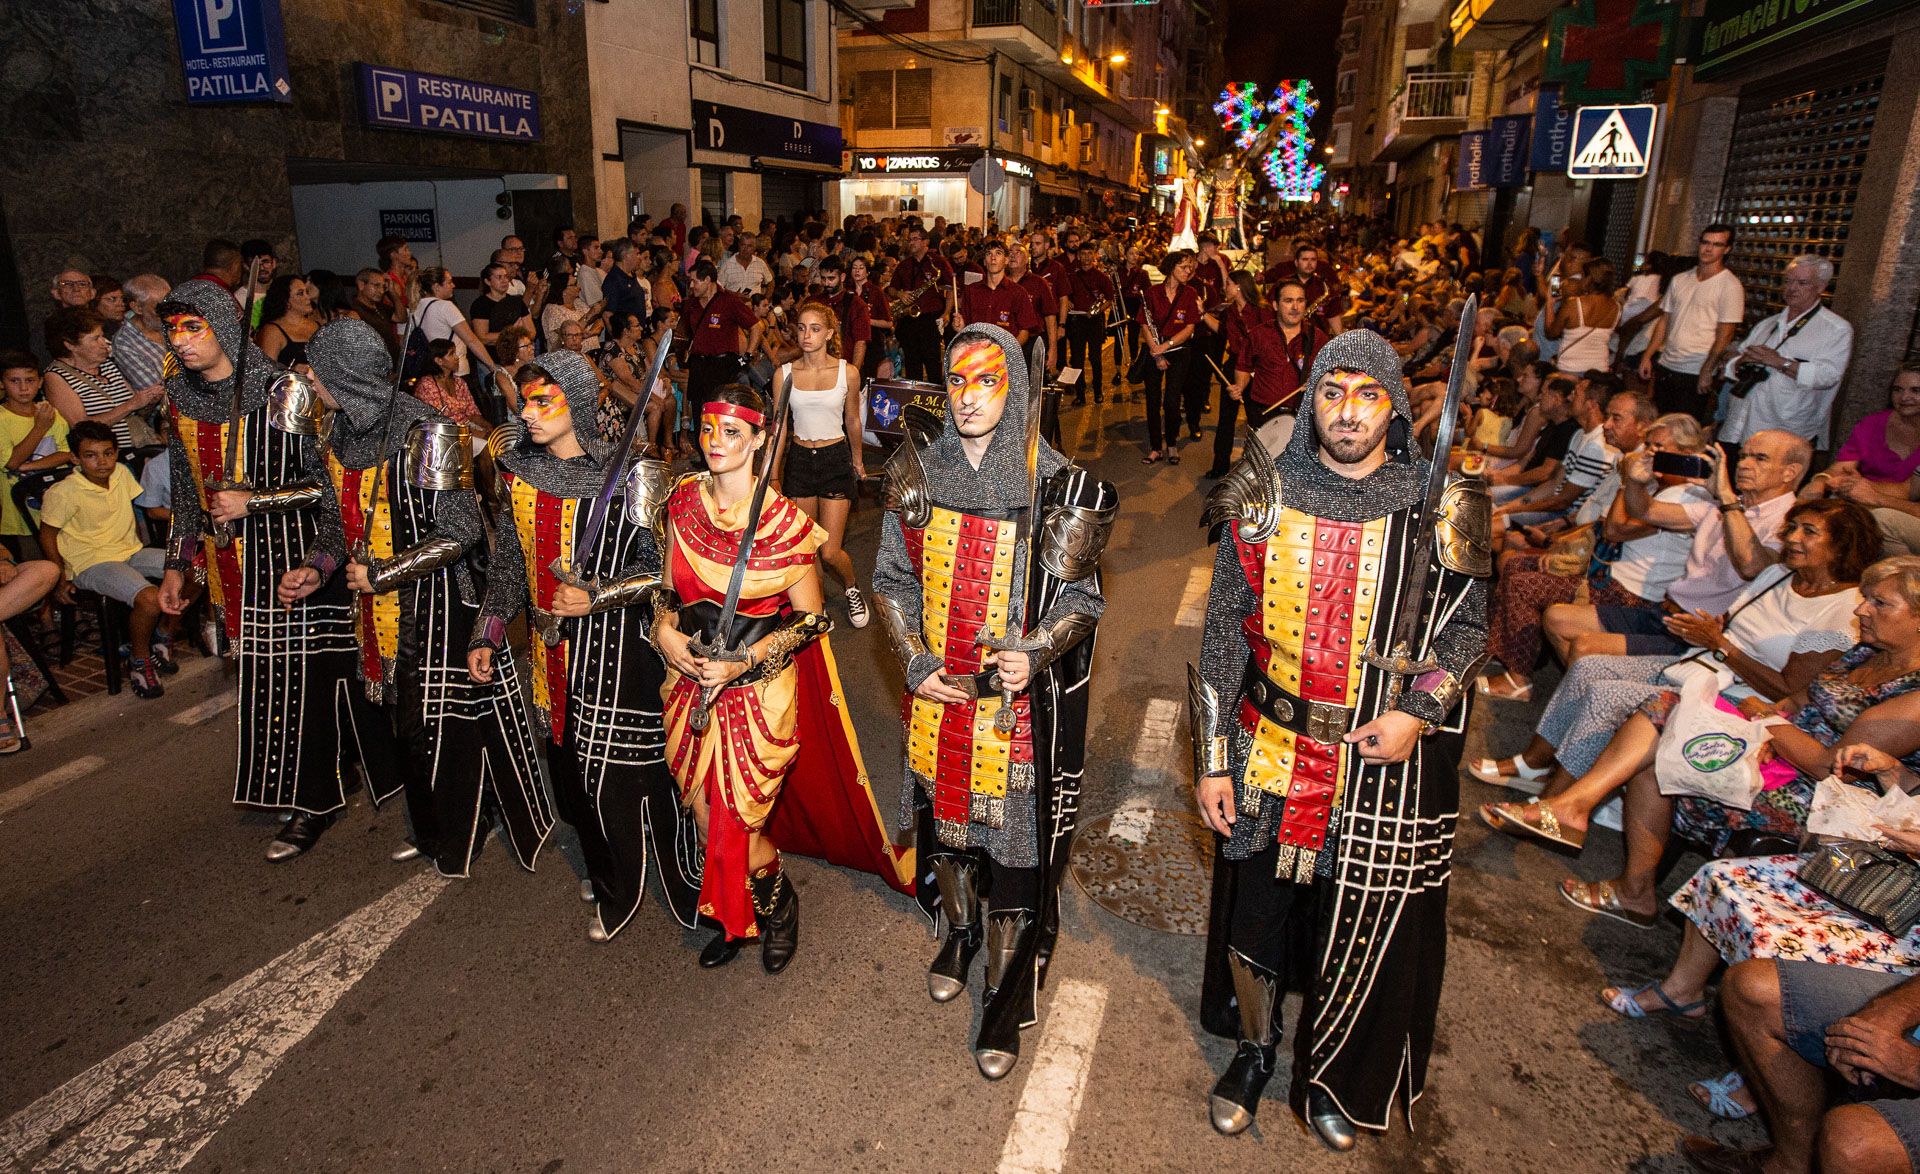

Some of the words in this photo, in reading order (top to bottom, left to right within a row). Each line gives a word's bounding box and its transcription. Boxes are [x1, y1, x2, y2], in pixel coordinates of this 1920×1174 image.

[213, 54, 266, 68] RESTAURANTE
[188, 72, 270, 97] PATILLA
[381, 80, 402, 113] P
[418, 77, 532, 110] RESTAURANTE
[420, 104, 533, 137] PATILLA
[860, 157, 876, 170] YO
[888, 156, 940, 169] ZAPATOS
[1468, 134, 1484, 189] nathalie
[1500, 120, 1518, 182] nathalie
[383, 213, 431, 224] PARKING
